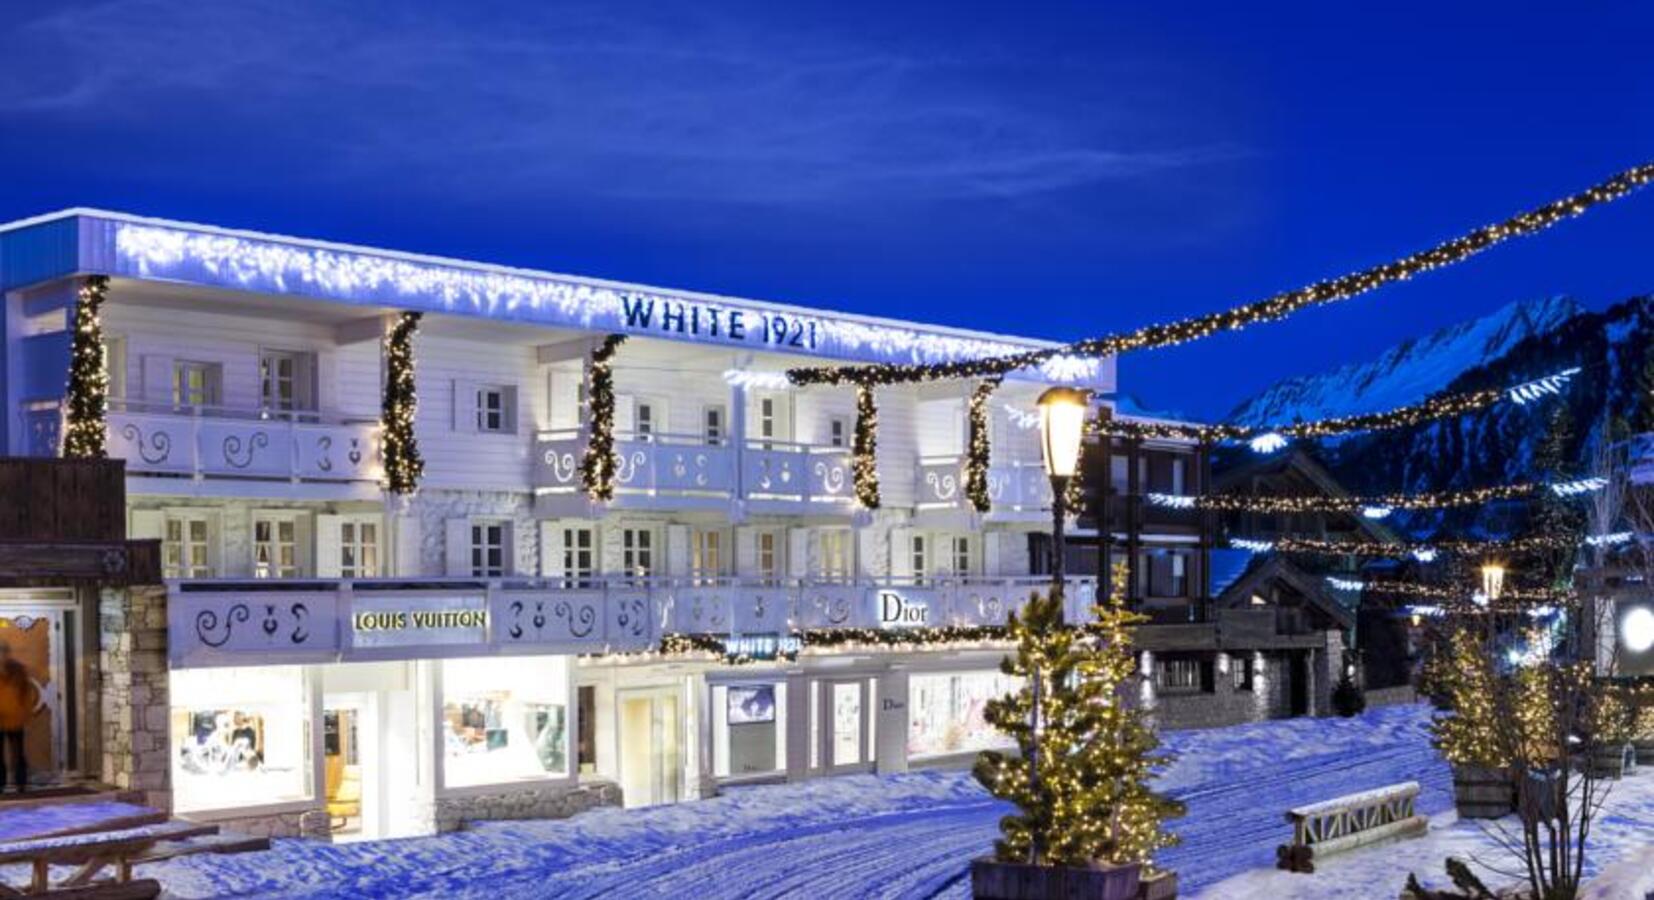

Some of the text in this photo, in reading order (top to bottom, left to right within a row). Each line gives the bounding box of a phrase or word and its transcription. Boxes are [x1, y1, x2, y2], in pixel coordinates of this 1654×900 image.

[621, 295, 816, 349] WHITE 1921
[881, 592, 929, 622] Dior
[355, 611, 486, 630] LOUIS VUITTON
[726, 637, 774, 655] WHITE
